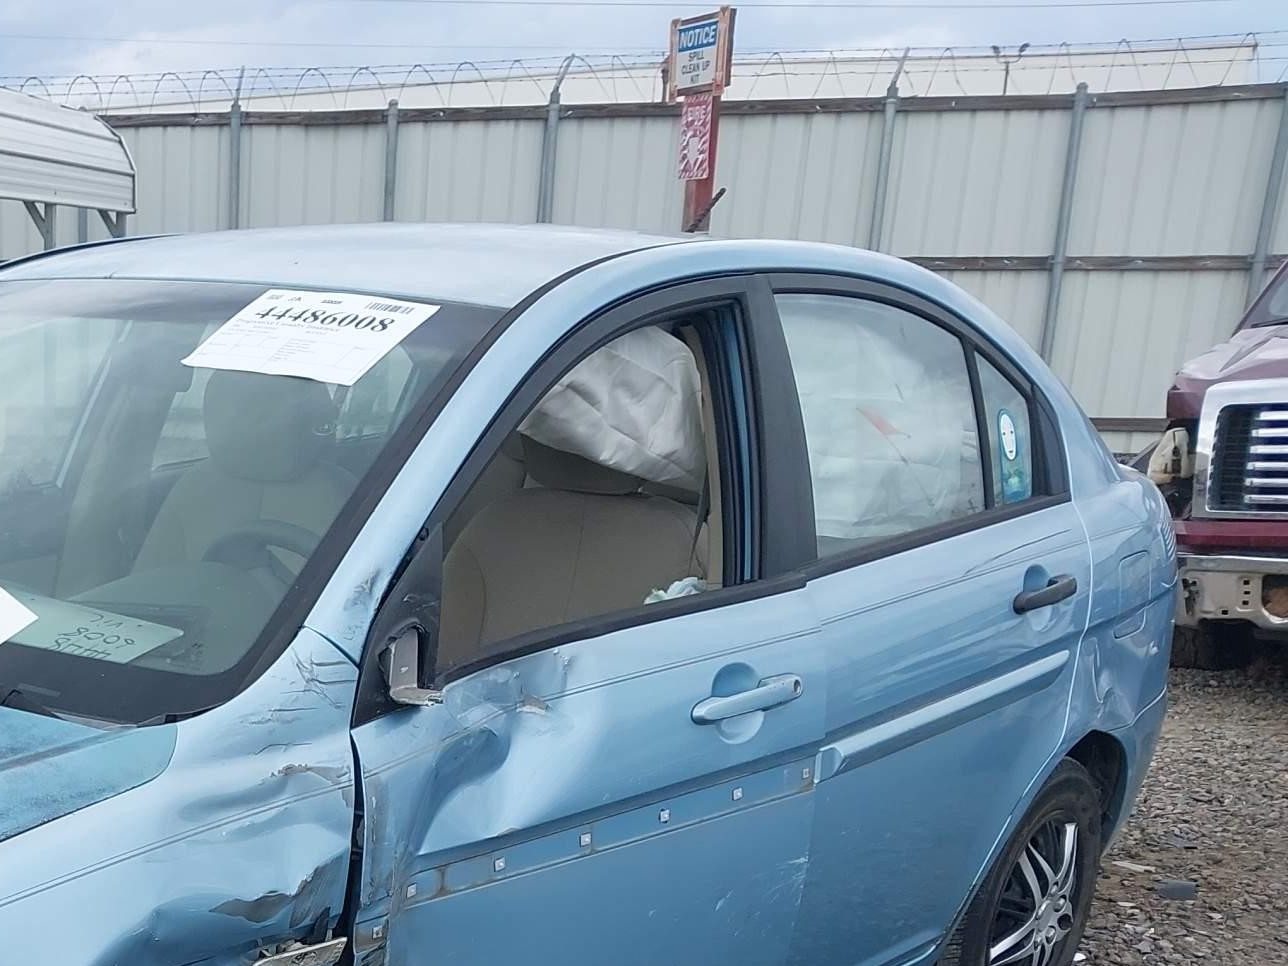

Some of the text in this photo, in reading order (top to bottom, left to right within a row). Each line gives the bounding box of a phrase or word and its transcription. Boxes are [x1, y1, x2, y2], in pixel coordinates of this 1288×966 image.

[679, 25, 717, 49] NOTICE
[688, 50, 705, 62] SPILL
[681, 60, 711, 75] CLEAN UP
[690, 74, 700, 83] KIT
[255, 305, 396, 332] 44486008
